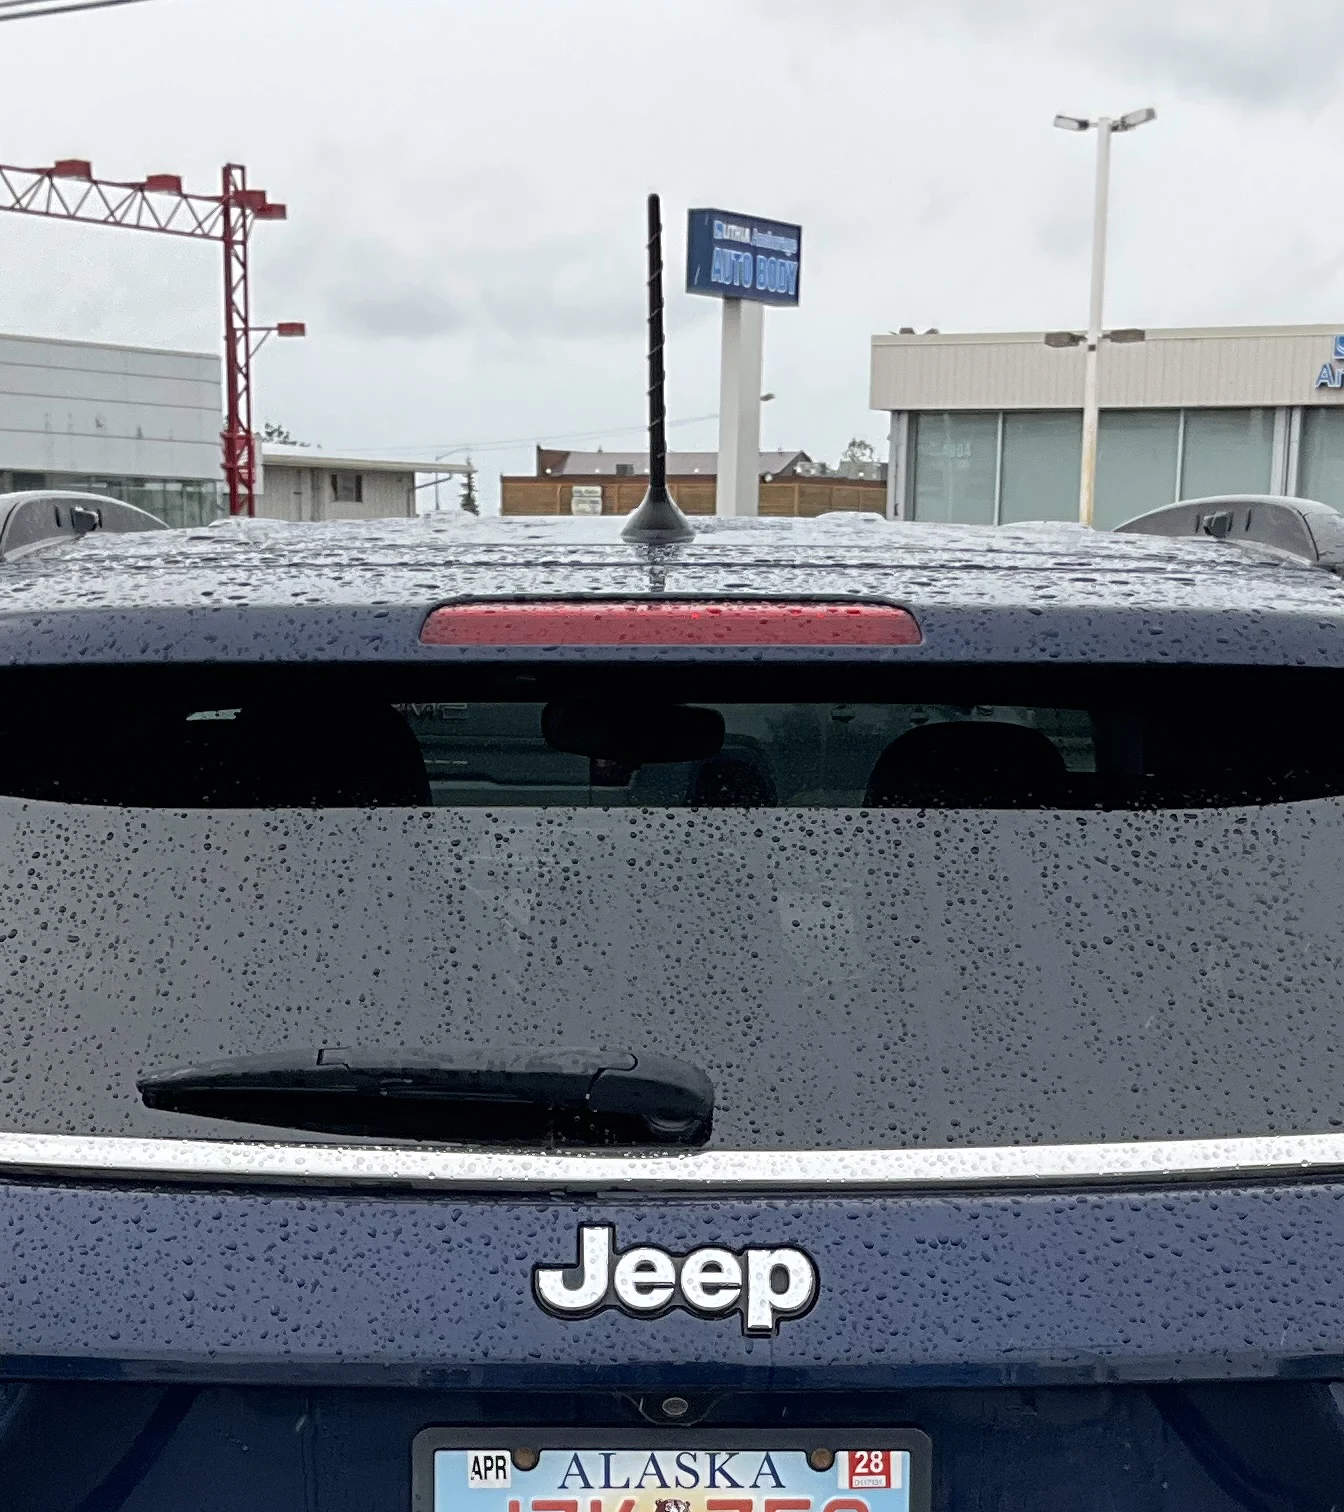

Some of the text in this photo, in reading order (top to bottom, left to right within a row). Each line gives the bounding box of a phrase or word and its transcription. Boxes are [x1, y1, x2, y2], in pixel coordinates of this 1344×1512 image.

[711, 247, 798, 296] AUTO BODY
[537, 1226, 817, 1330] Jeep
[471, 1455, 508, 1480] APR
[557, 1451, 786, 1490] ALASKA
[854, 1451, 885, 1474] 28
